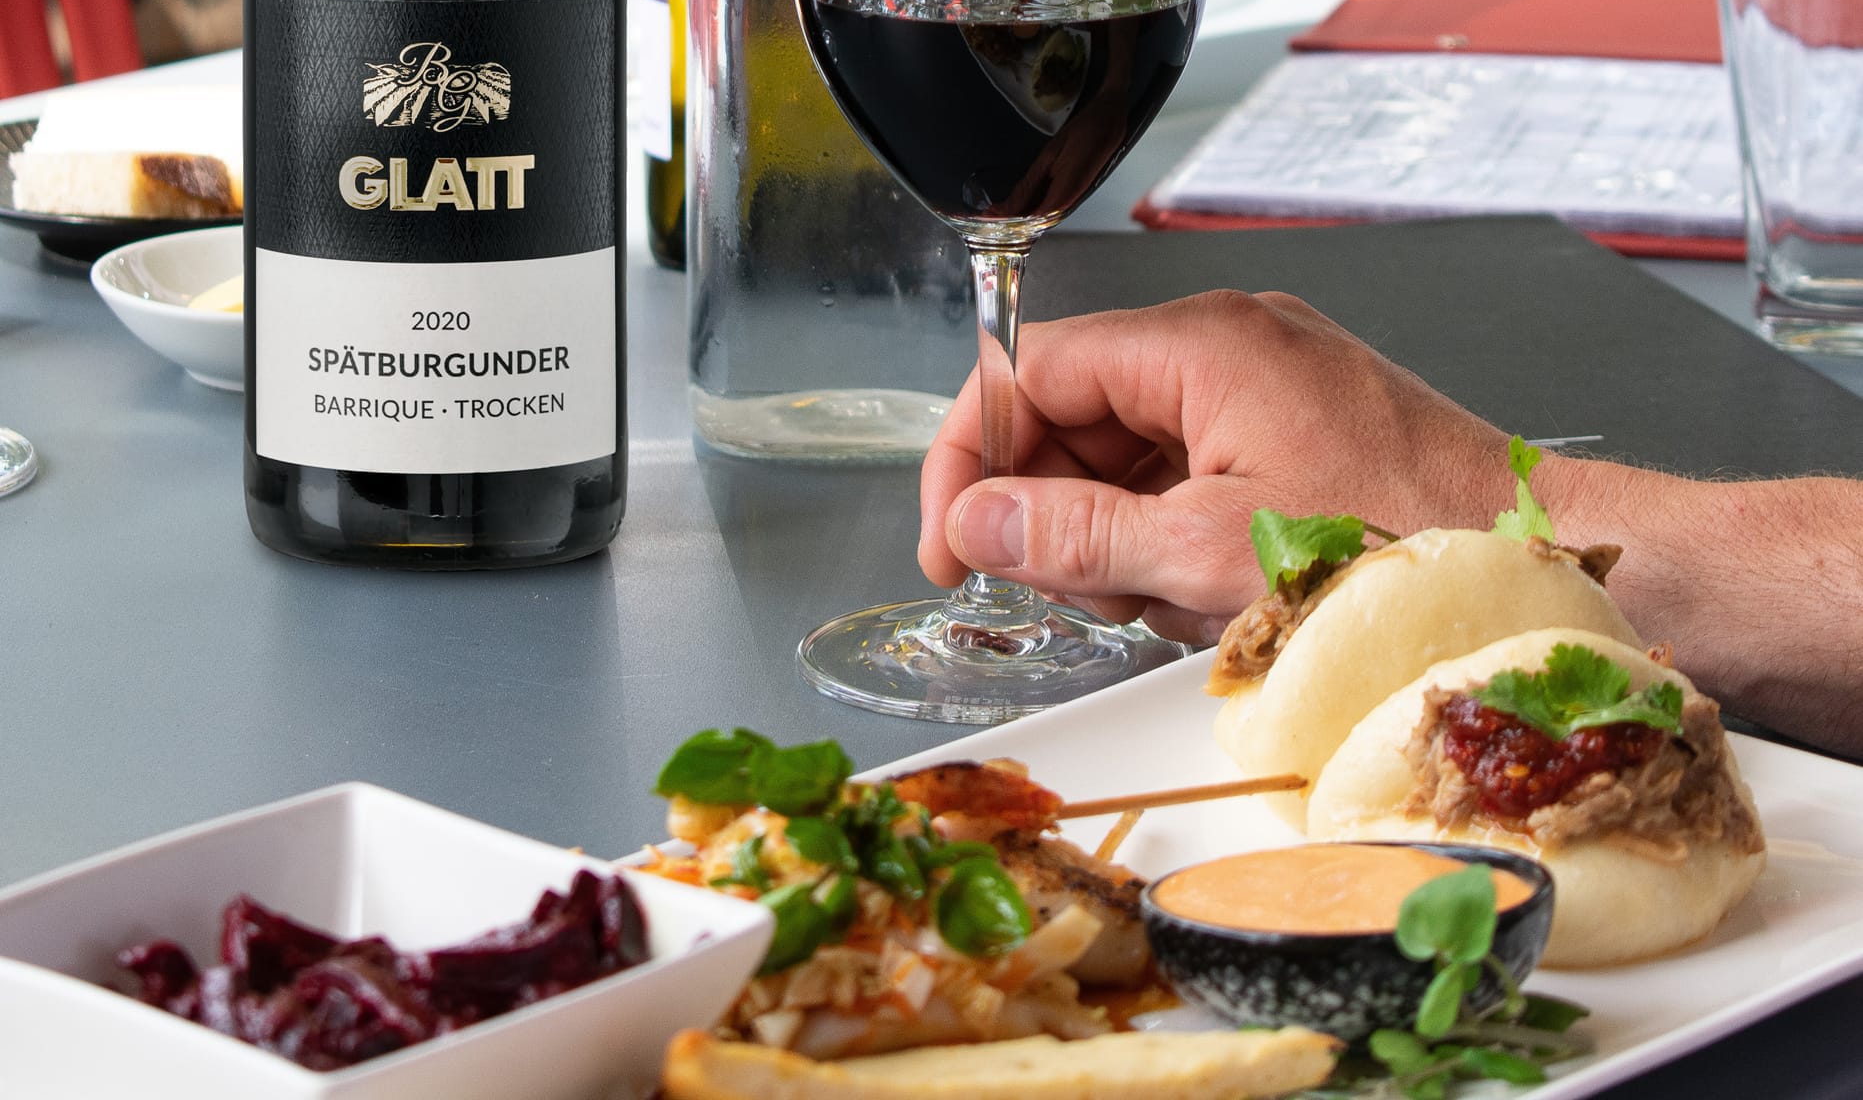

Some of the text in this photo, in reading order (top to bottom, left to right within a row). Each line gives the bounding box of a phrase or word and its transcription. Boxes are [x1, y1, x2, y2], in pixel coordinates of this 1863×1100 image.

[338, 154, 536, 212] GLATT
[411, 311, 470, 331] 2020
[308, 346, 570, 378] SPÄTBURGUNDER
[314, 392, 565, 423] BARRIQUE TROCKEN
